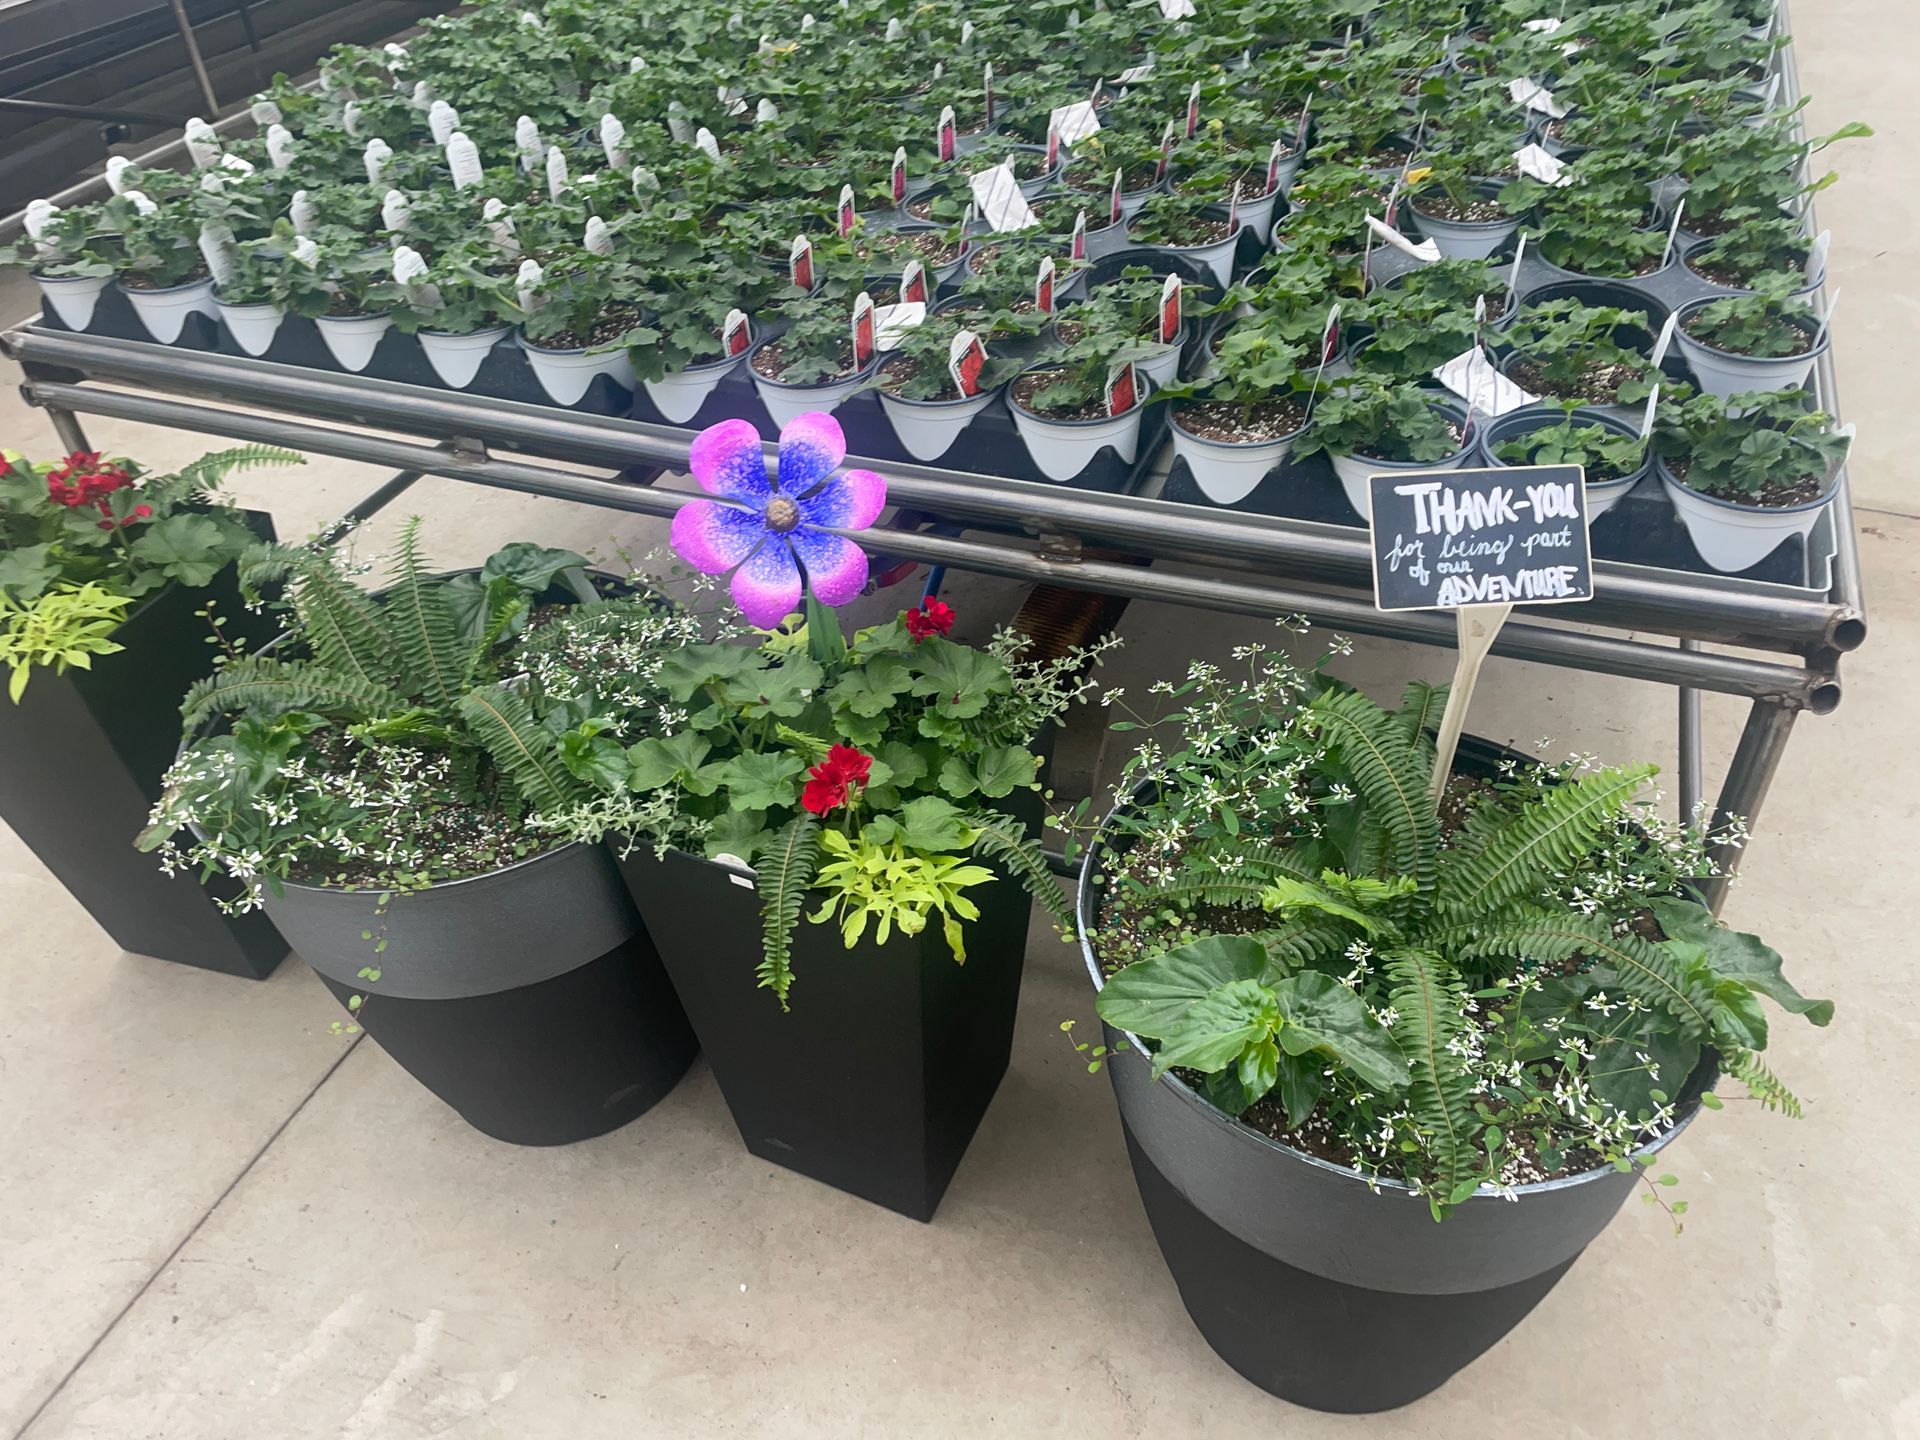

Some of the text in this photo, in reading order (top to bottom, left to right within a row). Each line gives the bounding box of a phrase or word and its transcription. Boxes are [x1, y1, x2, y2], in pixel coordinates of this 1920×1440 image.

[1394, 482, 1579, 535] THANK-YOU
[1384, 525, 1572, 572] for being part
[1409, 560, 1473, 586] of our
[1437, 566, 1579, 606] ADVENTURE
